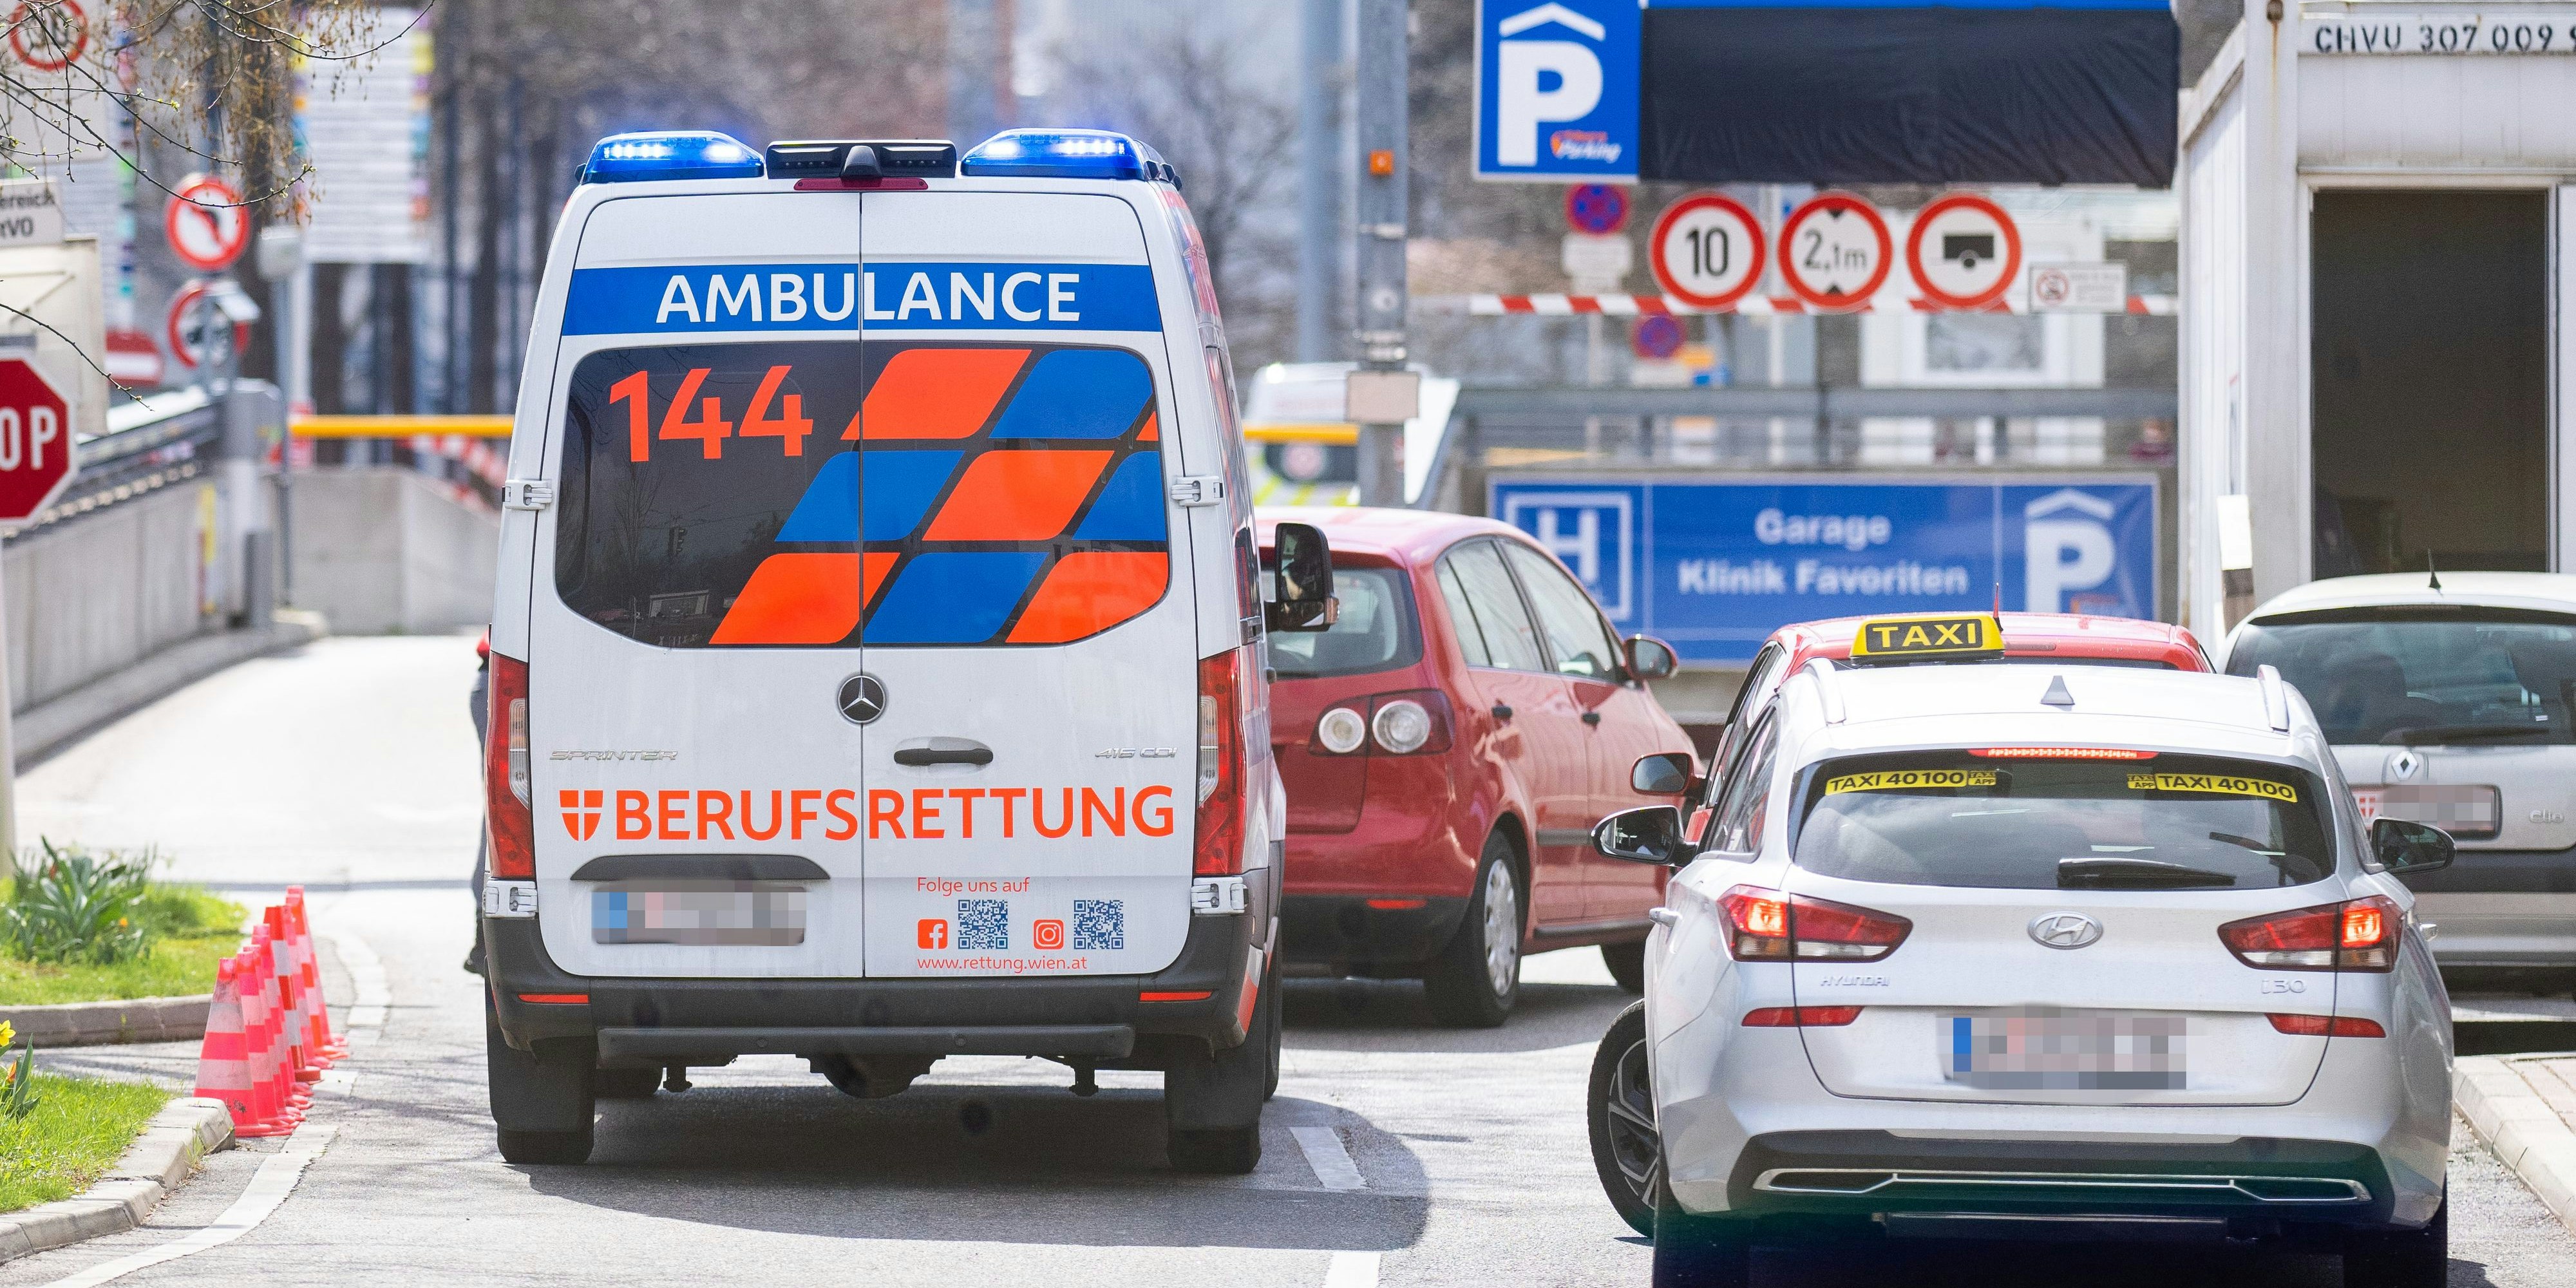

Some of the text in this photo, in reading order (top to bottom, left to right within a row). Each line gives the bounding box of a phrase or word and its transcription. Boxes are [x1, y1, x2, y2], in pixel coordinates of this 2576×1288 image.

[2315, 24, 2401, 52] CHVU
[2419, 24, 2478, 52] 307
[2492, 24, 2553, 52] 009
[1498, 40, 1604, 167] P
[1685, 227, 1728, 277] 10
[656, 272, 1081, 324] AMBULANCE
[609, 365, 813, 462] 144
[1754, 507, 1891, 552] Garage
[1537, 507, 1598, 583] H
[1678, 559, 1969, 596] Klinik Favoriten
[2025, 520, 2115, 612] P
[1872, 623, 1977, 648] TAXI
[549, 750, 678, 761] SPRINTER
[1095, 747, 1177, 759] 416 CDI
[1830, 773, 1880, 791] TAXI
[2158, 775, 2212, 790] TAXI
[616, 786, 1175, 841] BERUFSRETTUNG
[2529, 809, 2564, 823] Clio
[917, 877, 1030, 896] Folge uns auf
[917, 956, 1088, 973] www.rettung.wien.at
[1820, 976, 1890, 987] HYUNDAI
